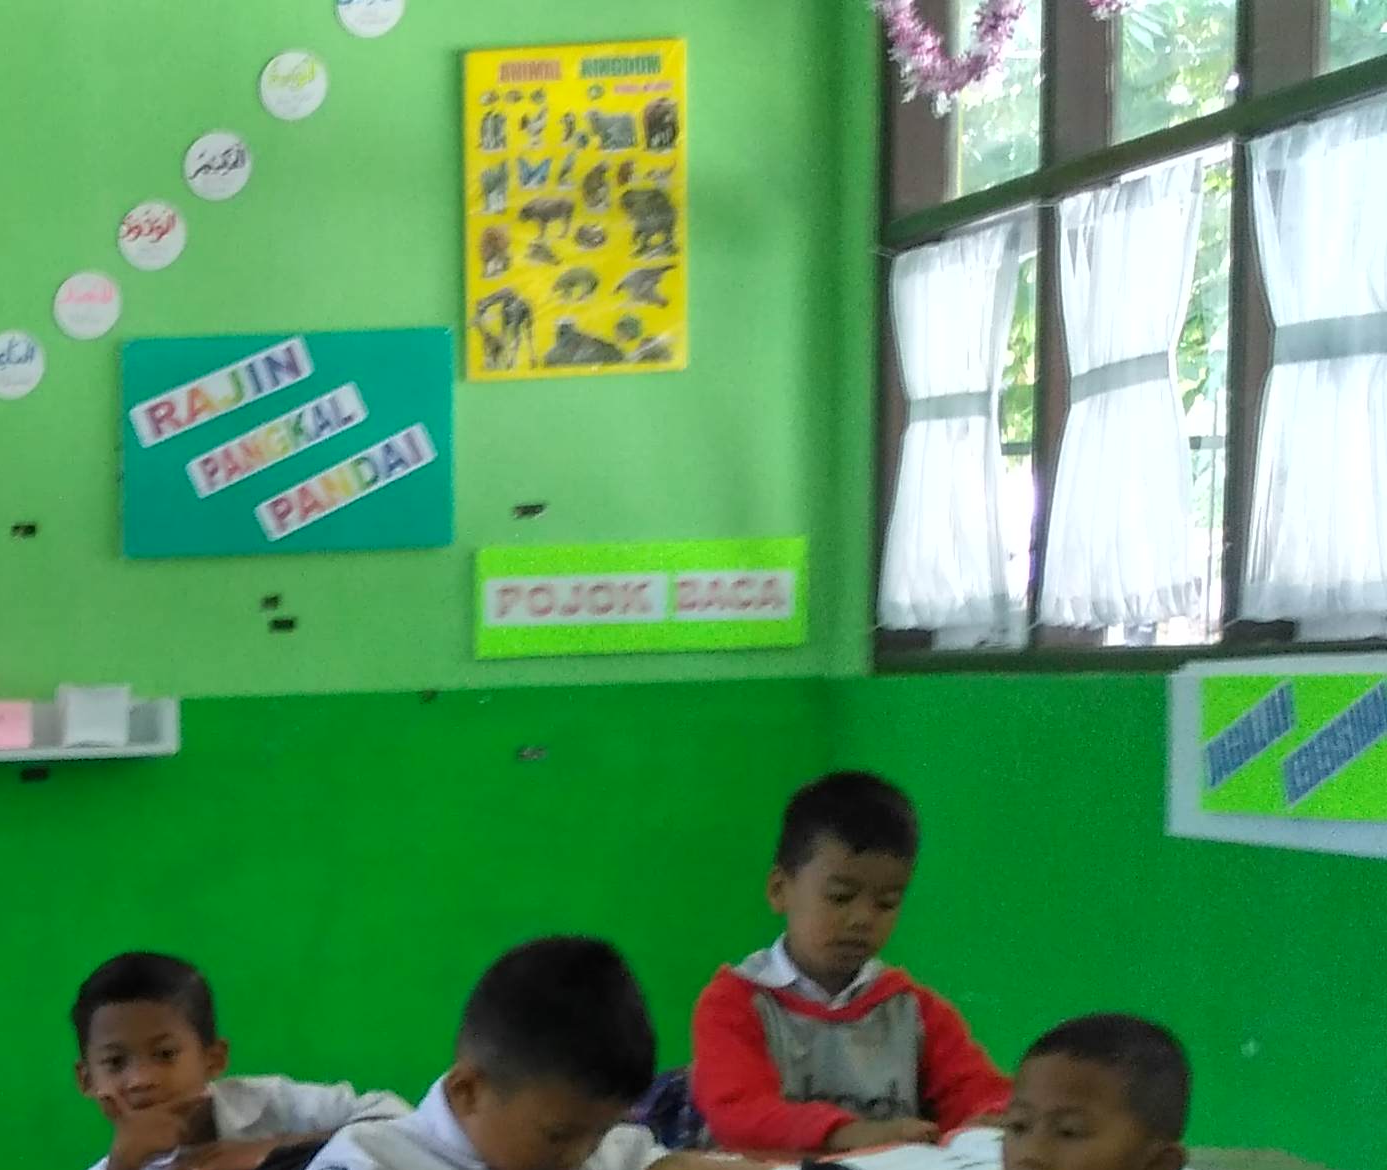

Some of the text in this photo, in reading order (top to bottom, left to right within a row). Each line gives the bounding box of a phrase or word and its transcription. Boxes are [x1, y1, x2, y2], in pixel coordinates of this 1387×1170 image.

[144, 346, 302, 438] RAJIN
[199, 395, 356, 490] PANGKAL
[269, 428, 425, 533] PANDAI
[494, 576, 786, 619] POJOK BACA
